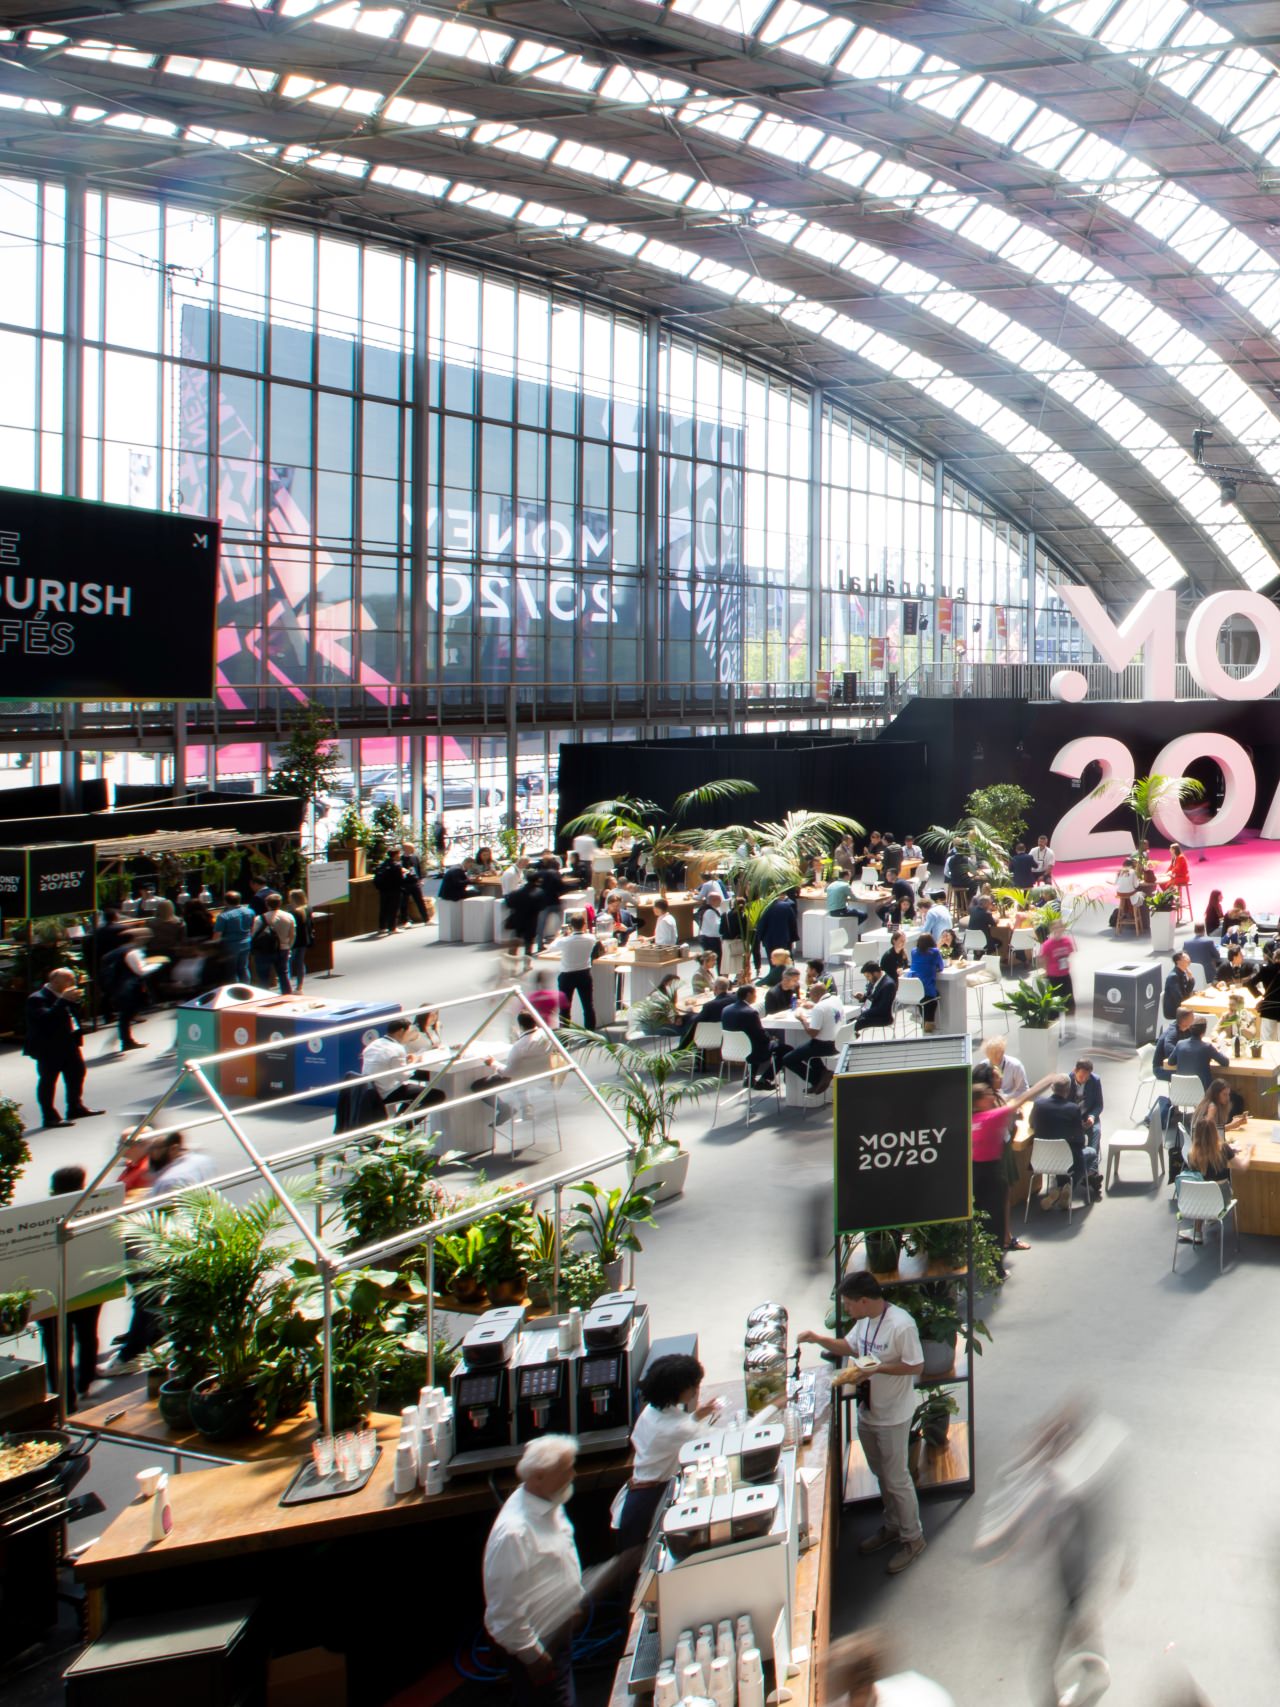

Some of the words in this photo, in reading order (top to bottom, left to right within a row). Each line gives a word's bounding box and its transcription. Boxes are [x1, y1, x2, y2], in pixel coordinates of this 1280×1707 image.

[0, 575, 131, 616] URISH
[40, 880, 80, 891] 20/20
[41, 870, 86, 883] MONEY
[859, 1128, 947, 1152] MONEY
[859, 1148, 938, 1170] 20/20
